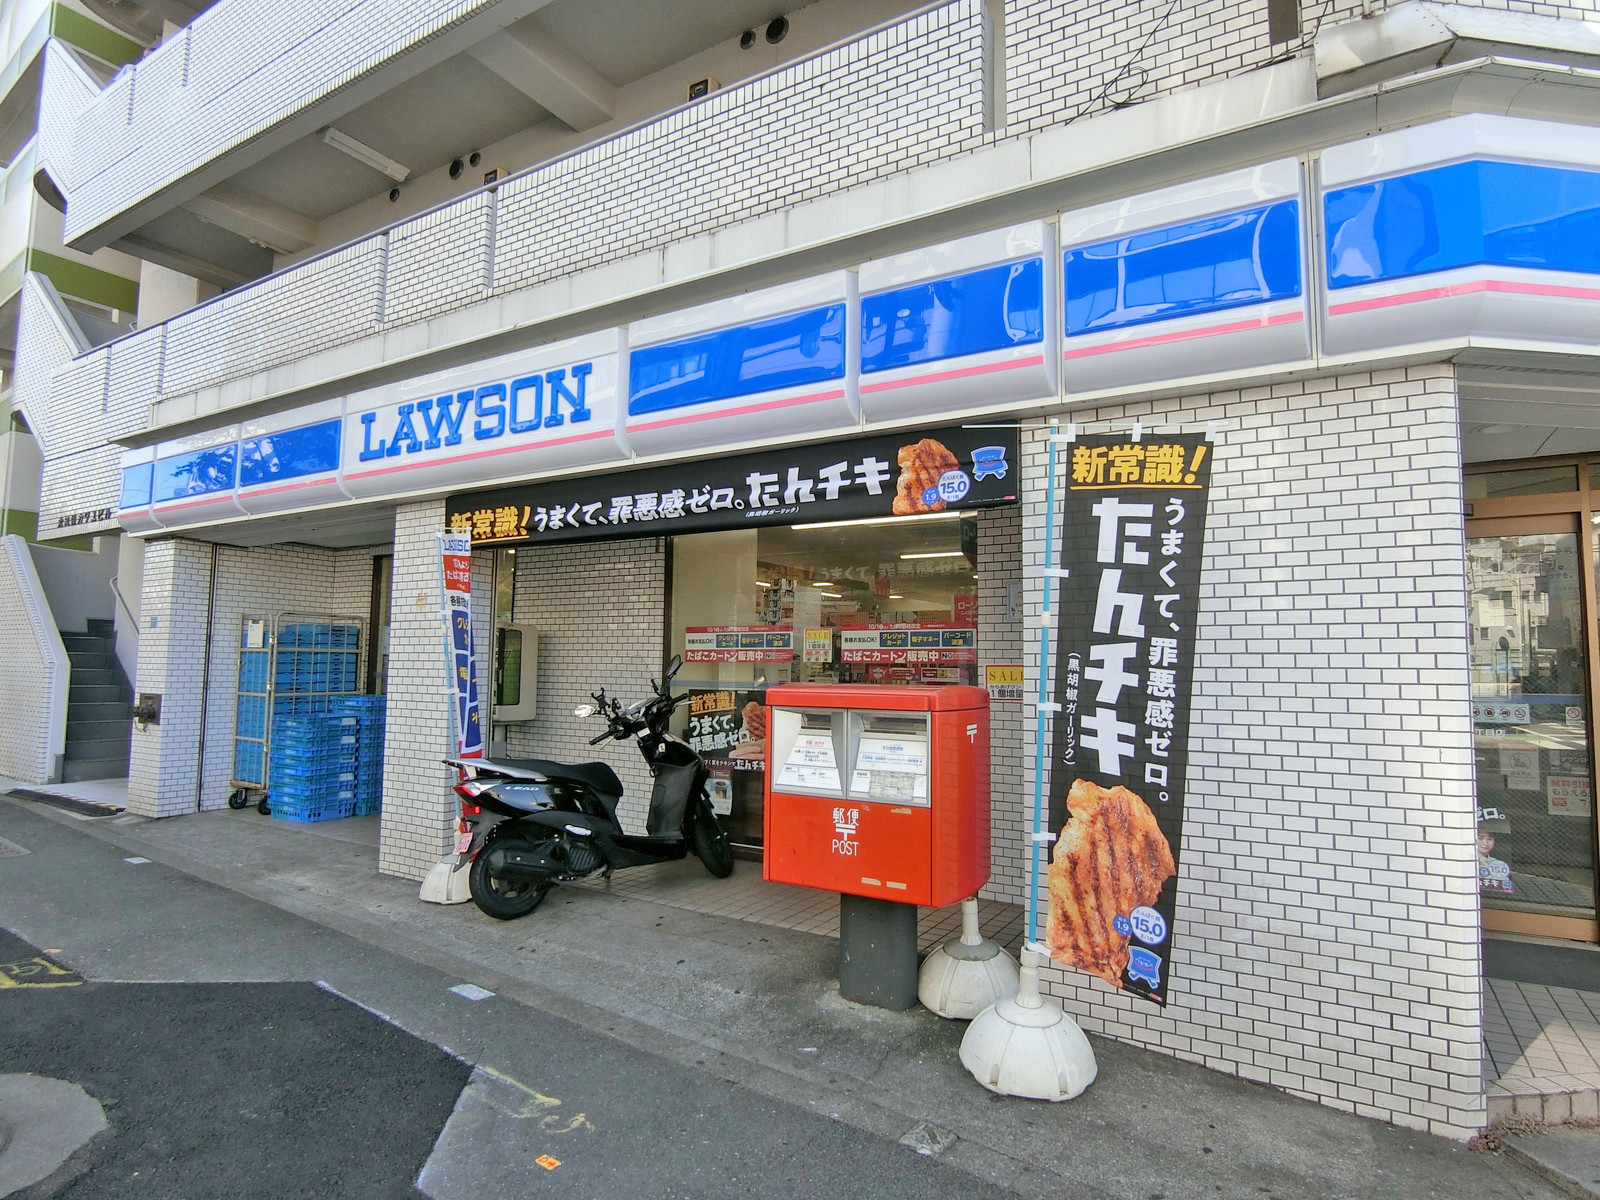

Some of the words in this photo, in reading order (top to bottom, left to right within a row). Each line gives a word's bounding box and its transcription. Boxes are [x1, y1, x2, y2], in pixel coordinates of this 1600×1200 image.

[359, 362, 593, 462] LAWSON
[1072, 444, 1207, 484] 新常識!
[450, 506, 532, 538] 新常識!
[534, 485, 745, 532] うまくて、罪悪感ゼロ。
[746, 457, 890, 508] たんチキ
[940, 481, 967, 494] 15.0
[807, 632, 829, 640] SALE
[1080, 497, 1154, 776] たんチキ
[687, 651, 764, 661] たばこカートン販売中
[843, 650, 939, 662] たばこカートン販売中
[1144, 497, 1186, 802] うまくて、罪悪感ゼロ。
[690, 690, 737, 712] 新常識!
[1063, 652, 1081, 766] (黒胡椒ガーリック)
[689, 714, 735, 737] うまくて、
[689, 729, 756, 754] 罪悪感ゼロ。
[832, 807, 860, 826] 郵便
[831, 839, 859, 856] POST
[1117, 921, 1130, 931] 1.9
[1132, 916, 1163, 937] 15.0
